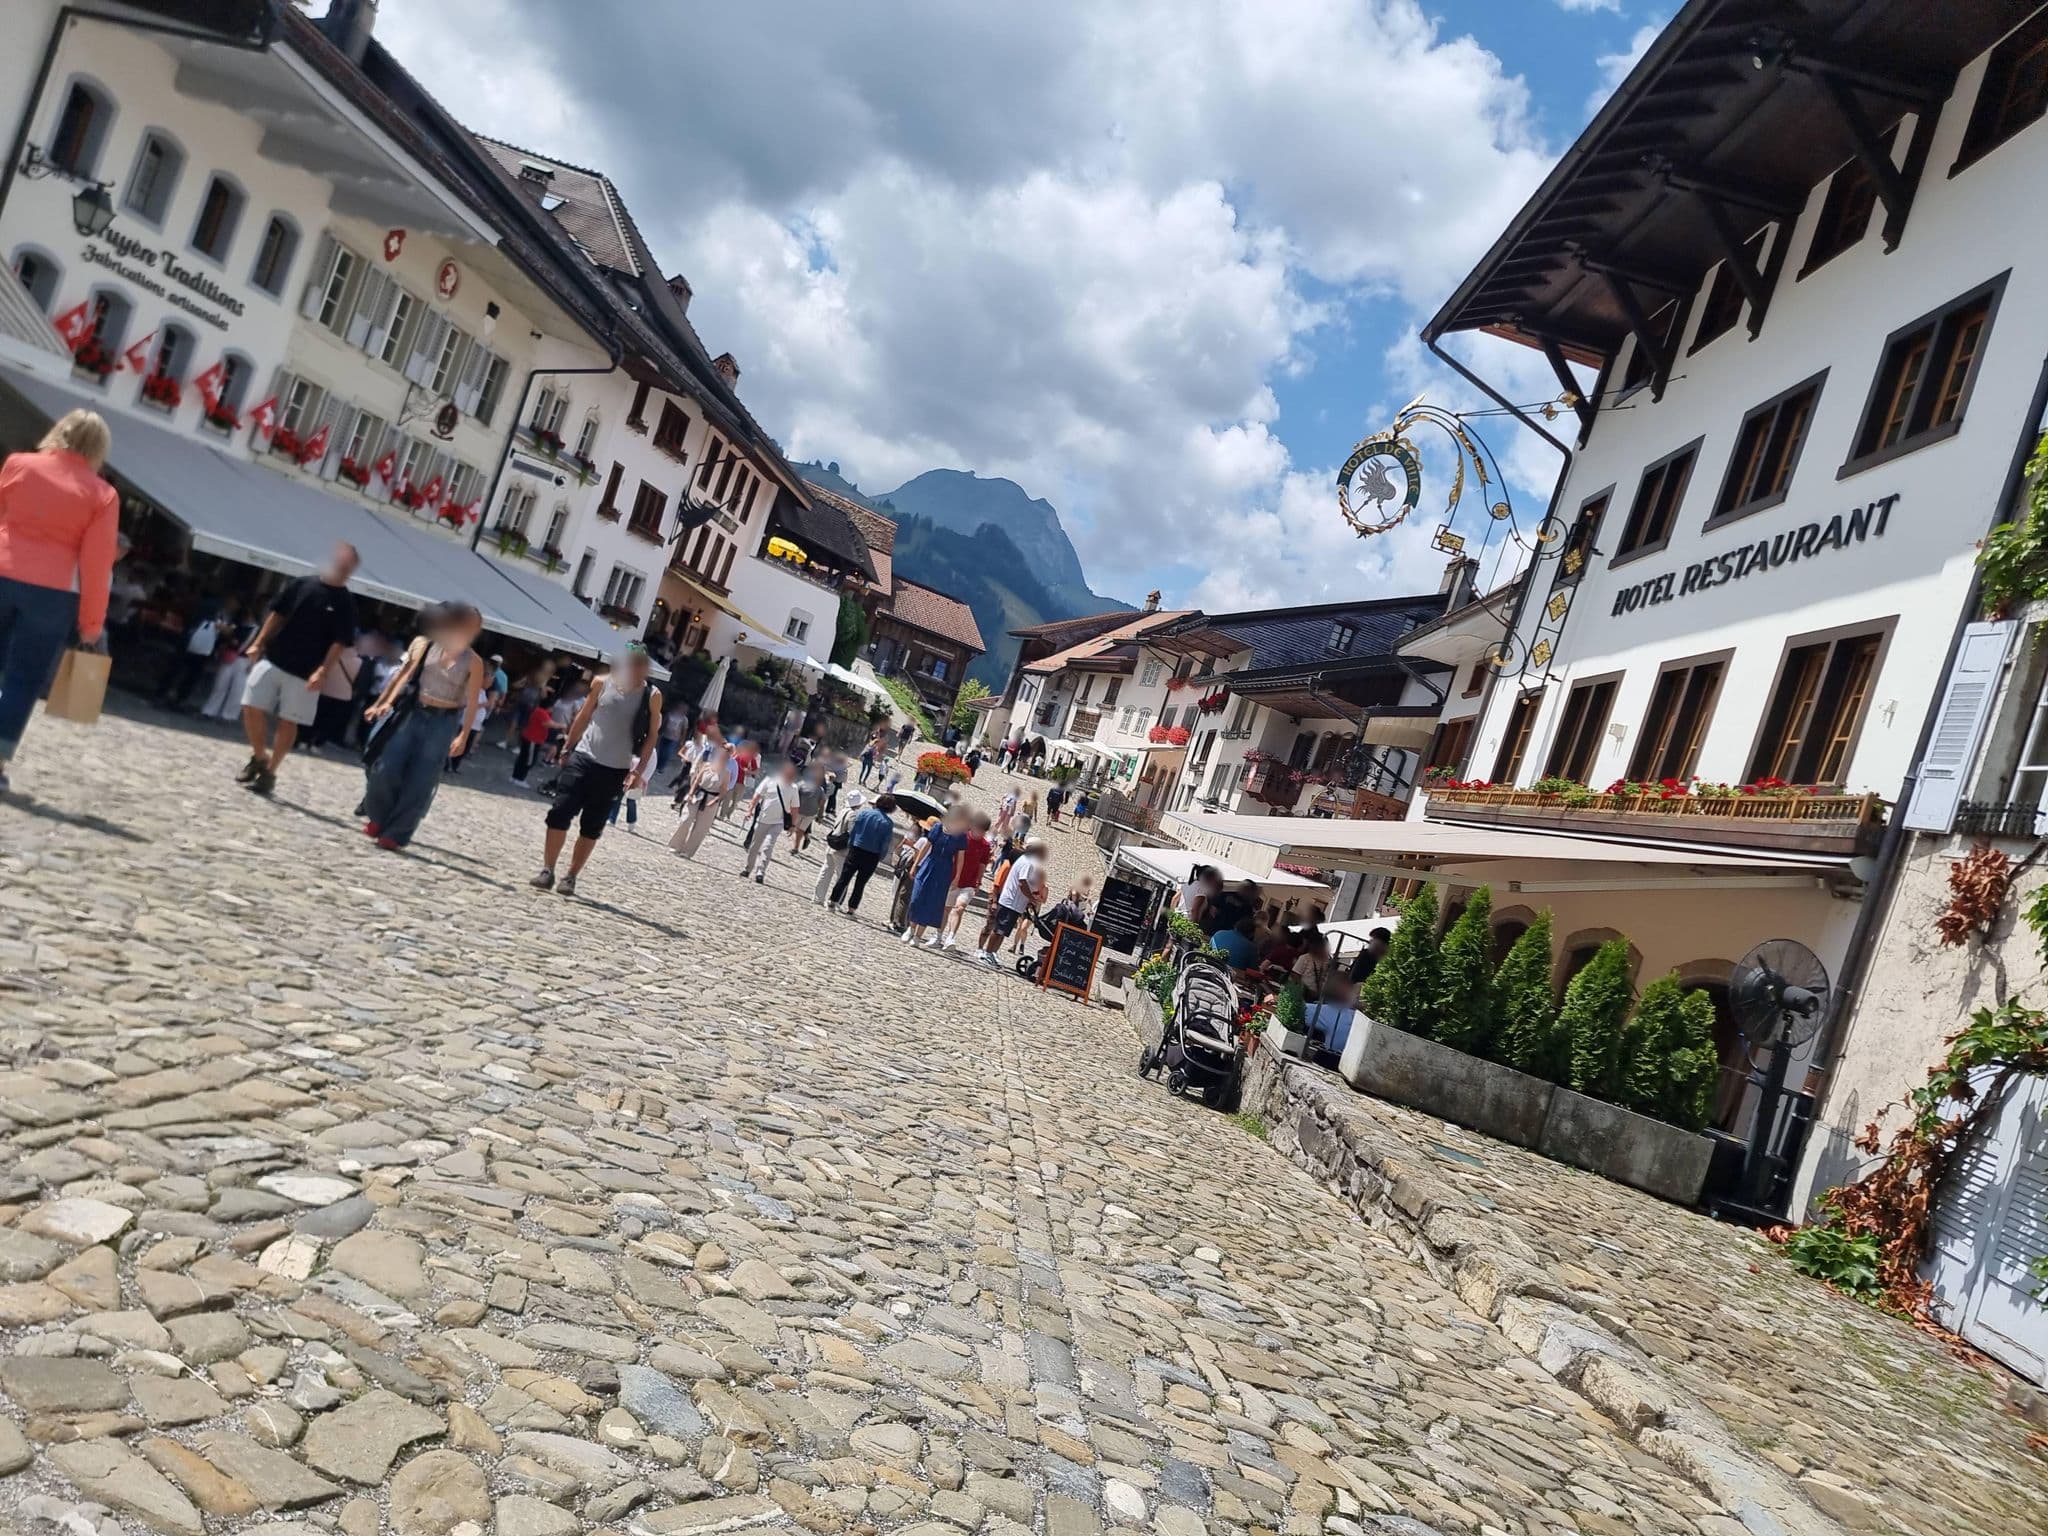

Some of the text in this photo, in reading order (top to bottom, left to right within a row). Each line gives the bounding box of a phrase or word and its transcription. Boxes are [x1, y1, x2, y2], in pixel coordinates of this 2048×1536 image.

[80, 244, 165, 298] Fabrications
[161, 250, 246, 318] Traditions
[1384, 443, 1404, 459] DE
[1404, 457, 1419, 496] VILLE
[1611, 493, 1900, 617] HOTEL RESTAURANT
